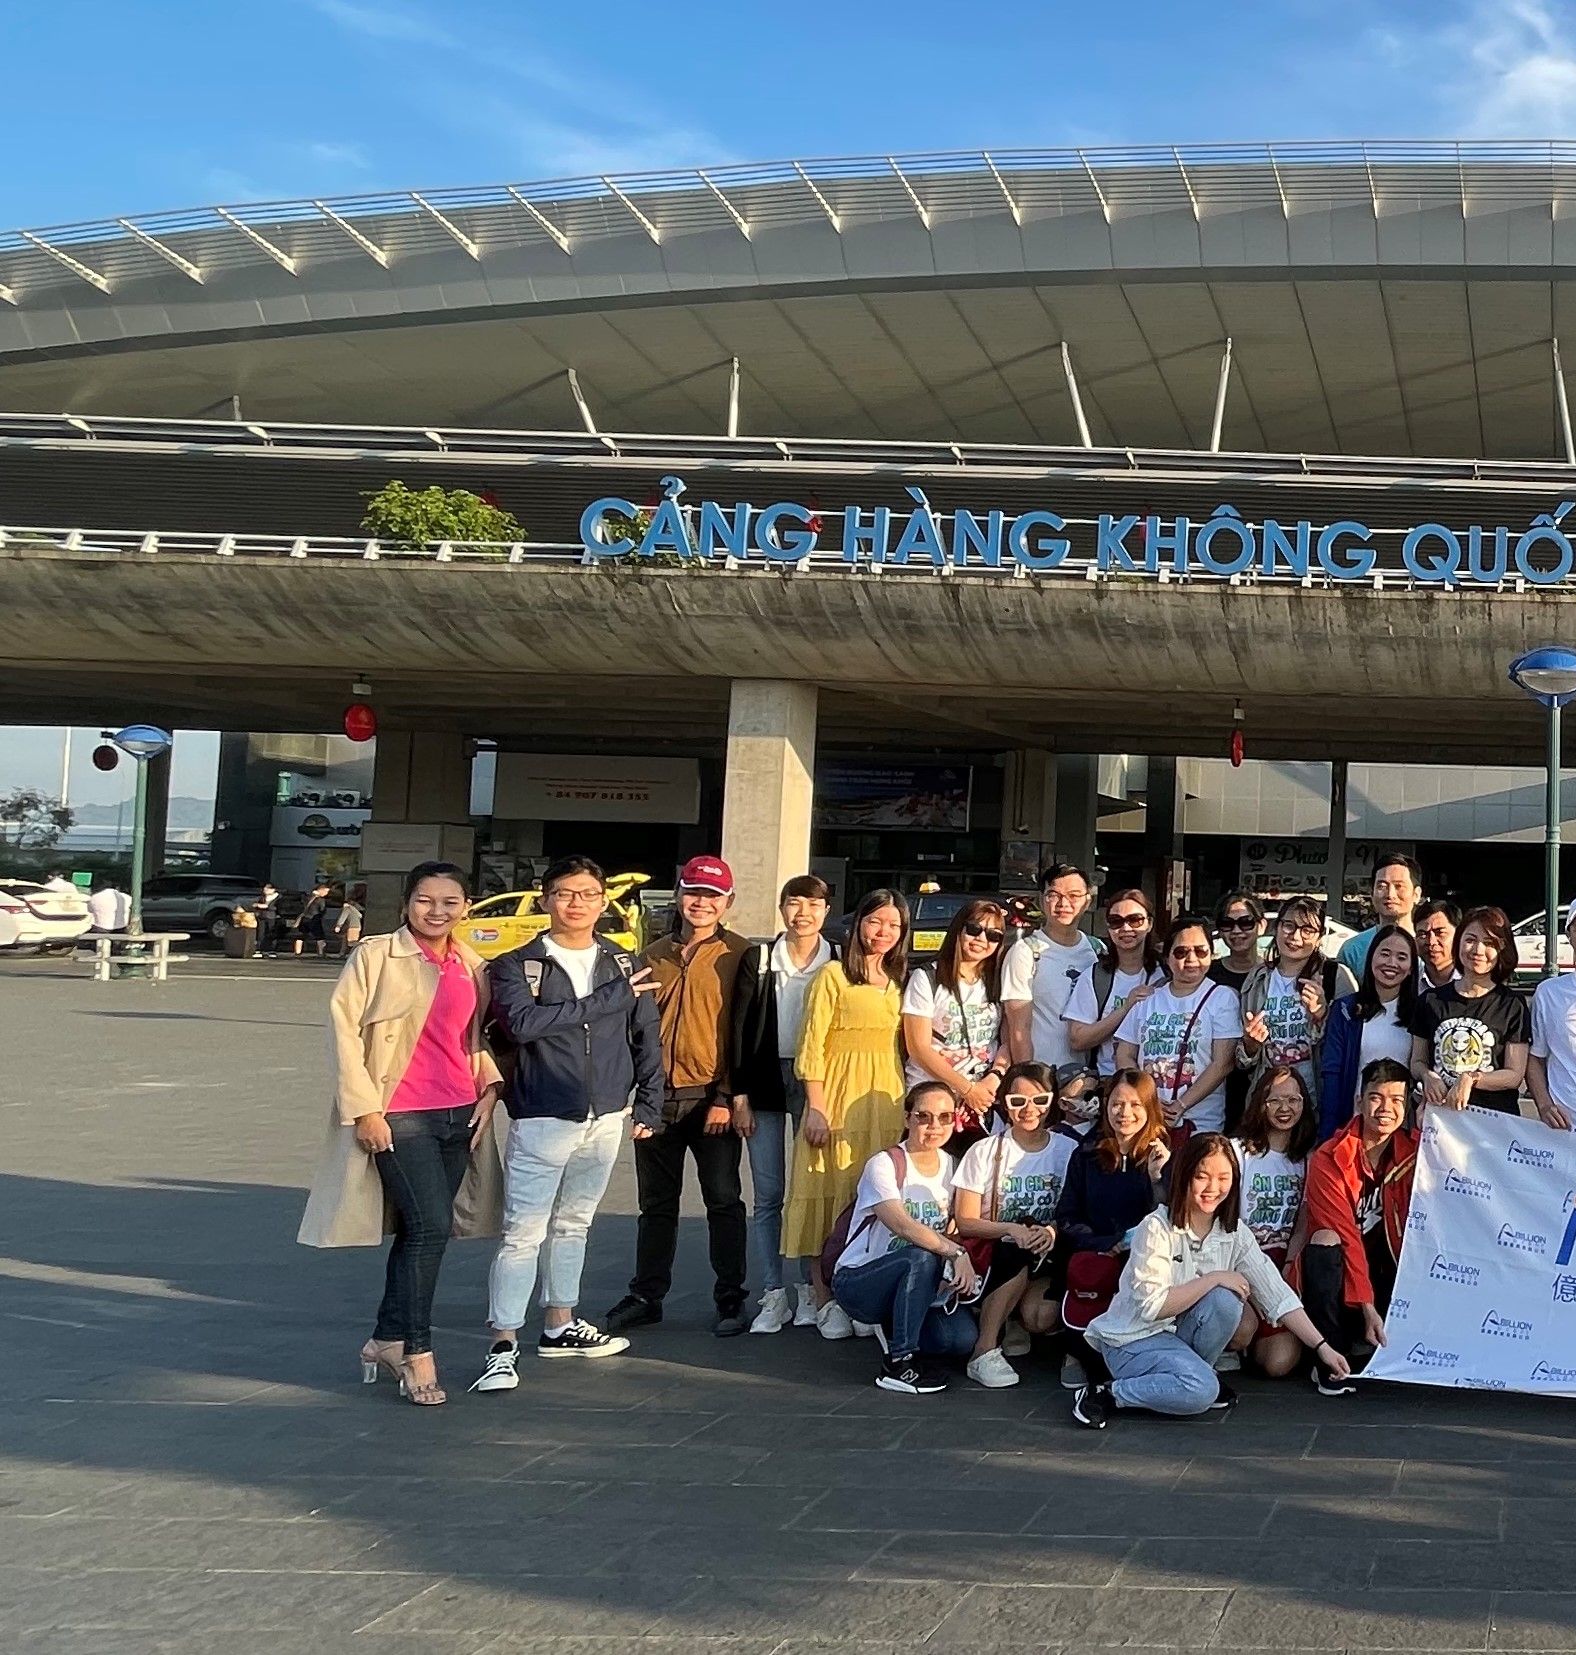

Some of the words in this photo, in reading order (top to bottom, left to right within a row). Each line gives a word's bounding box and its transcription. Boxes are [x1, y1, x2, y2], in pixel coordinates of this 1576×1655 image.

[579, 475, 818, 560] CẢNG
[843, 486, 1071, 569] HÀNG
[1097, 503, 1377, 580] KHÔNG
